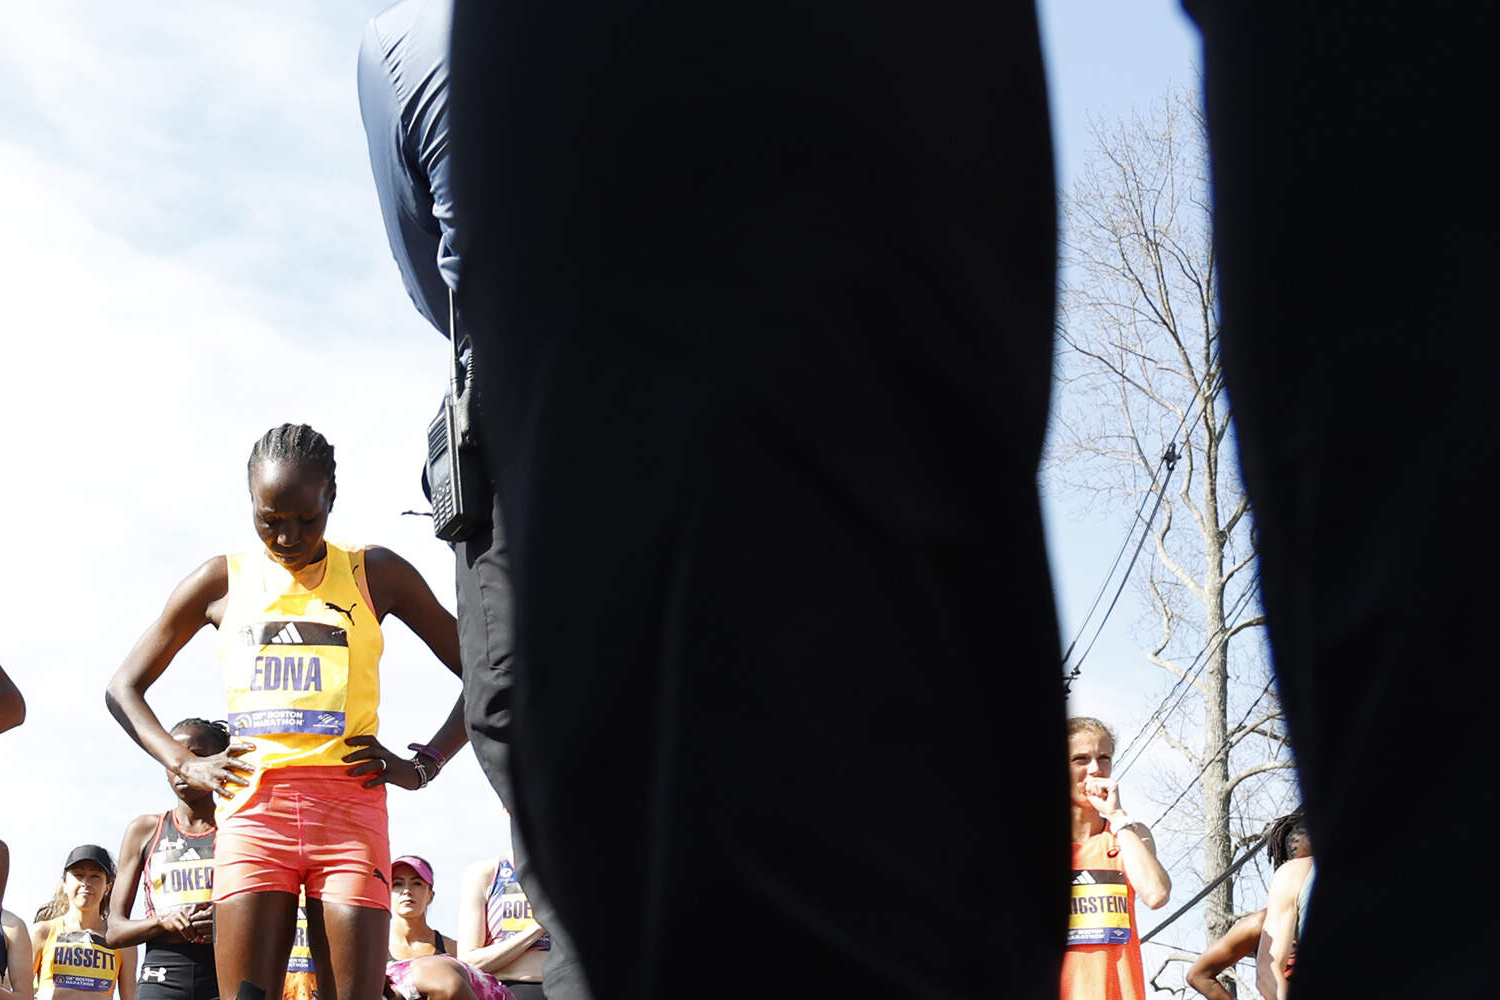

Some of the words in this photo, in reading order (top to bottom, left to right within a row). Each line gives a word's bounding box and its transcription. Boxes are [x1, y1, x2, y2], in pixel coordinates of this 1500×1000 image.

[250, 656, 322, 692] EDNA
[252, 718, 304, 727] MARATHON
[267, 711, 303, 719] BOSTON
[54, 946, 115, 971] HASSETT
